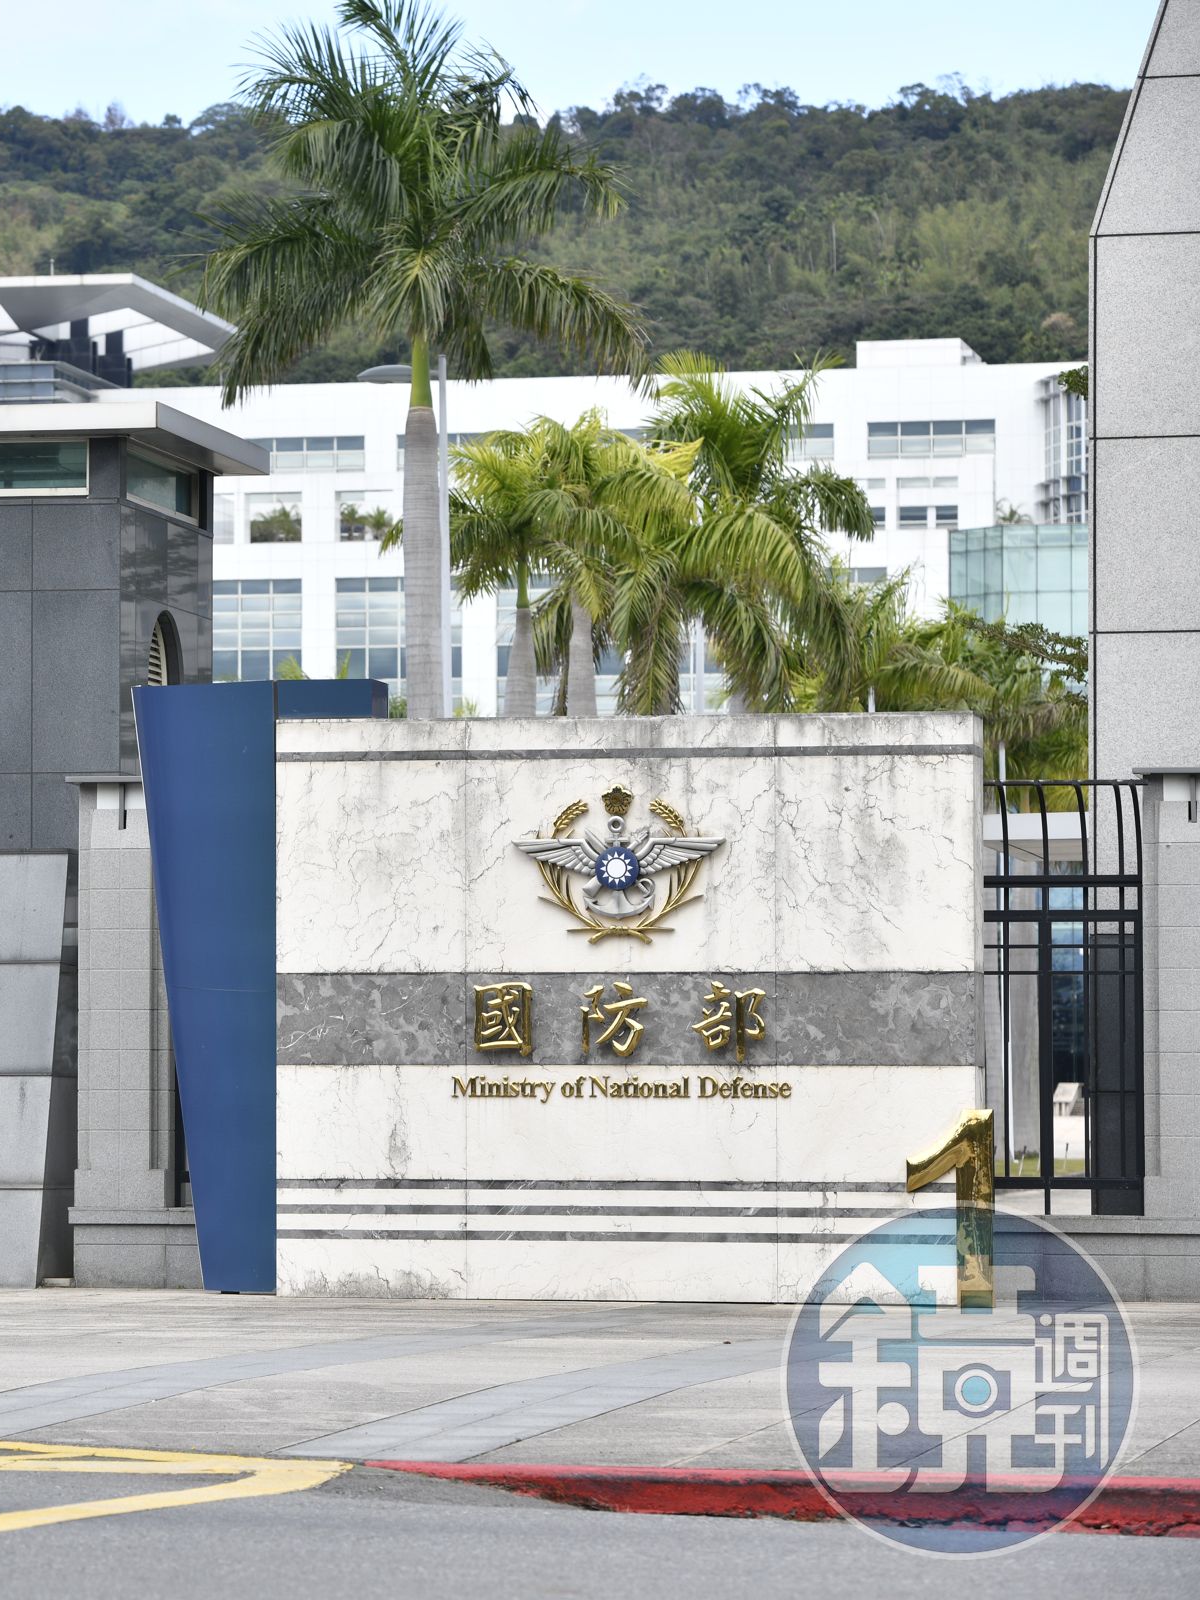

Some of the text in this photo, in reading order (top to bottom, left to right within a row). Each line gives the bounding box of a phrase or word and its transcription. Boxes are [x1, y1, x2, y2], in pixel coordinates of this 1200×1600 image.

[473, 981, 768, 1063] 國防部
[451, 1074, 793, 1104] Ministry of National Defense
